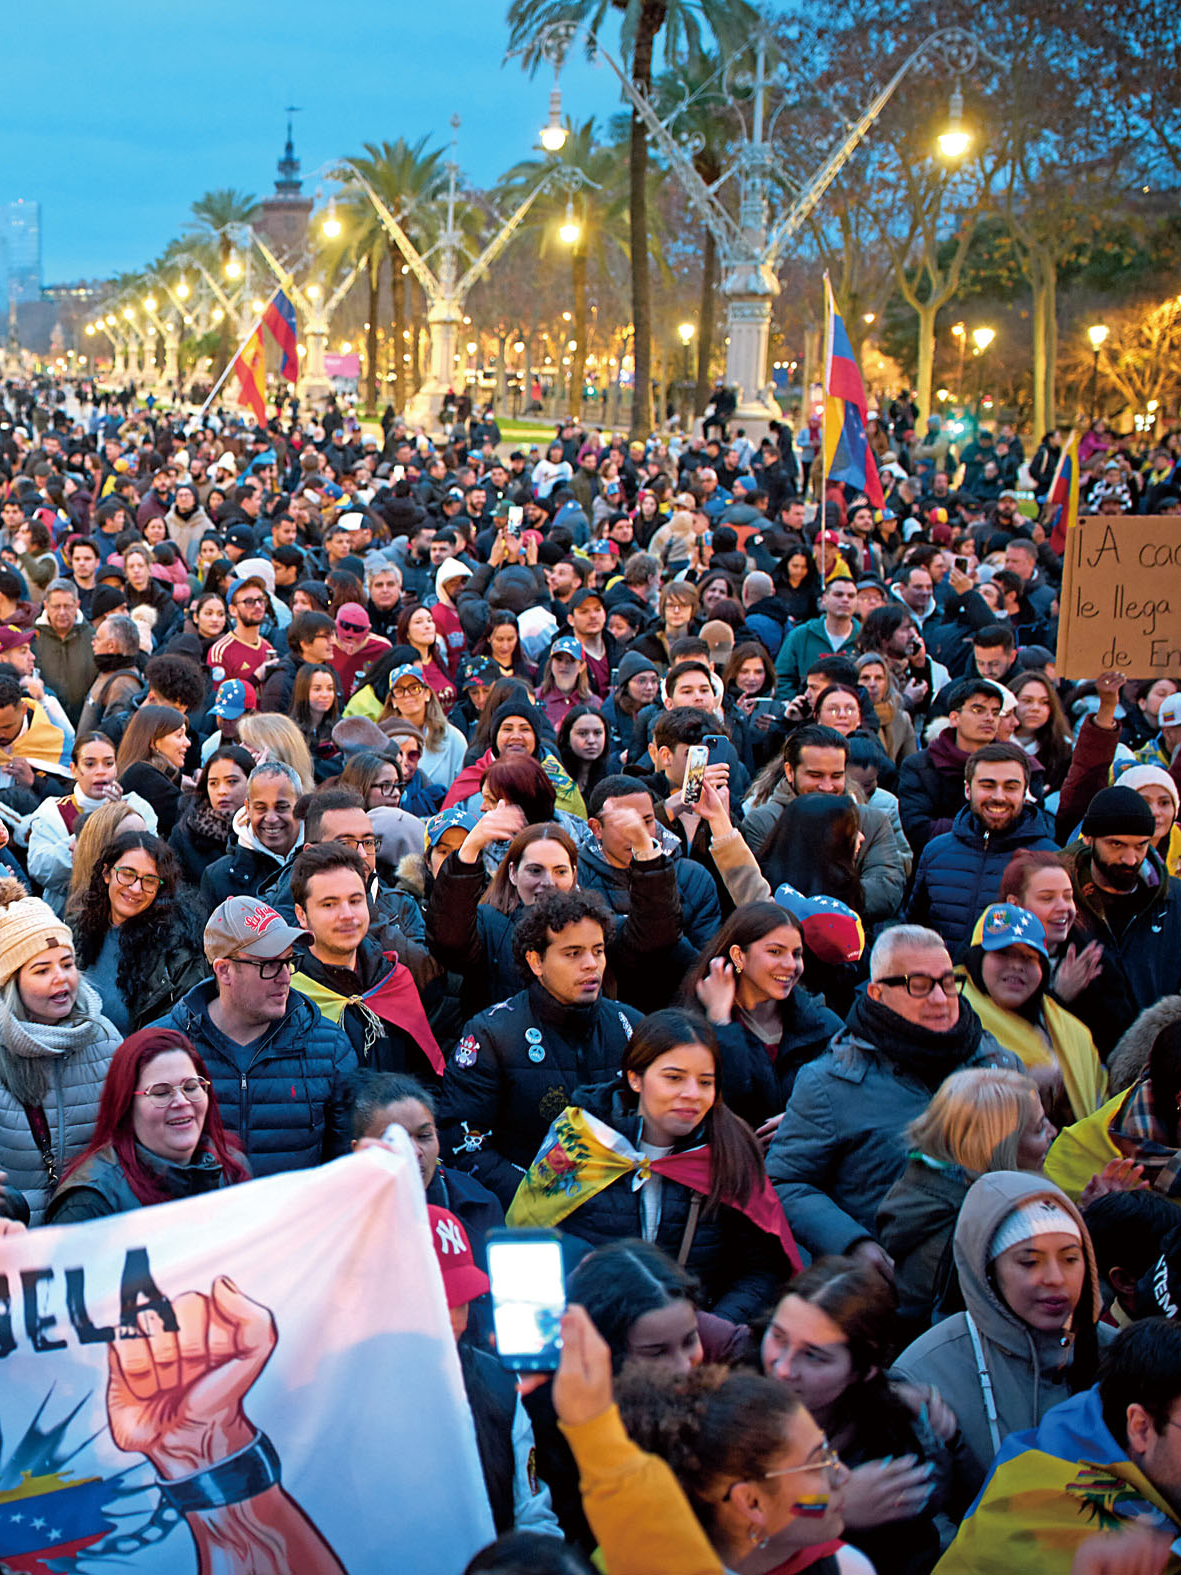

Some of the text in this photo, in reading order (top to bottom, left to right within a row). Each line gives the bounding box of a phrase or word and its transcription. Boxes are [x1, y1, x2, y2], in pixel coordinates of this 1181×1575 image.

[1076, 584, 1171, 636] le llega
[1101, 636, 1133, 669] de
[435, 1218, 467, 1254] NY
